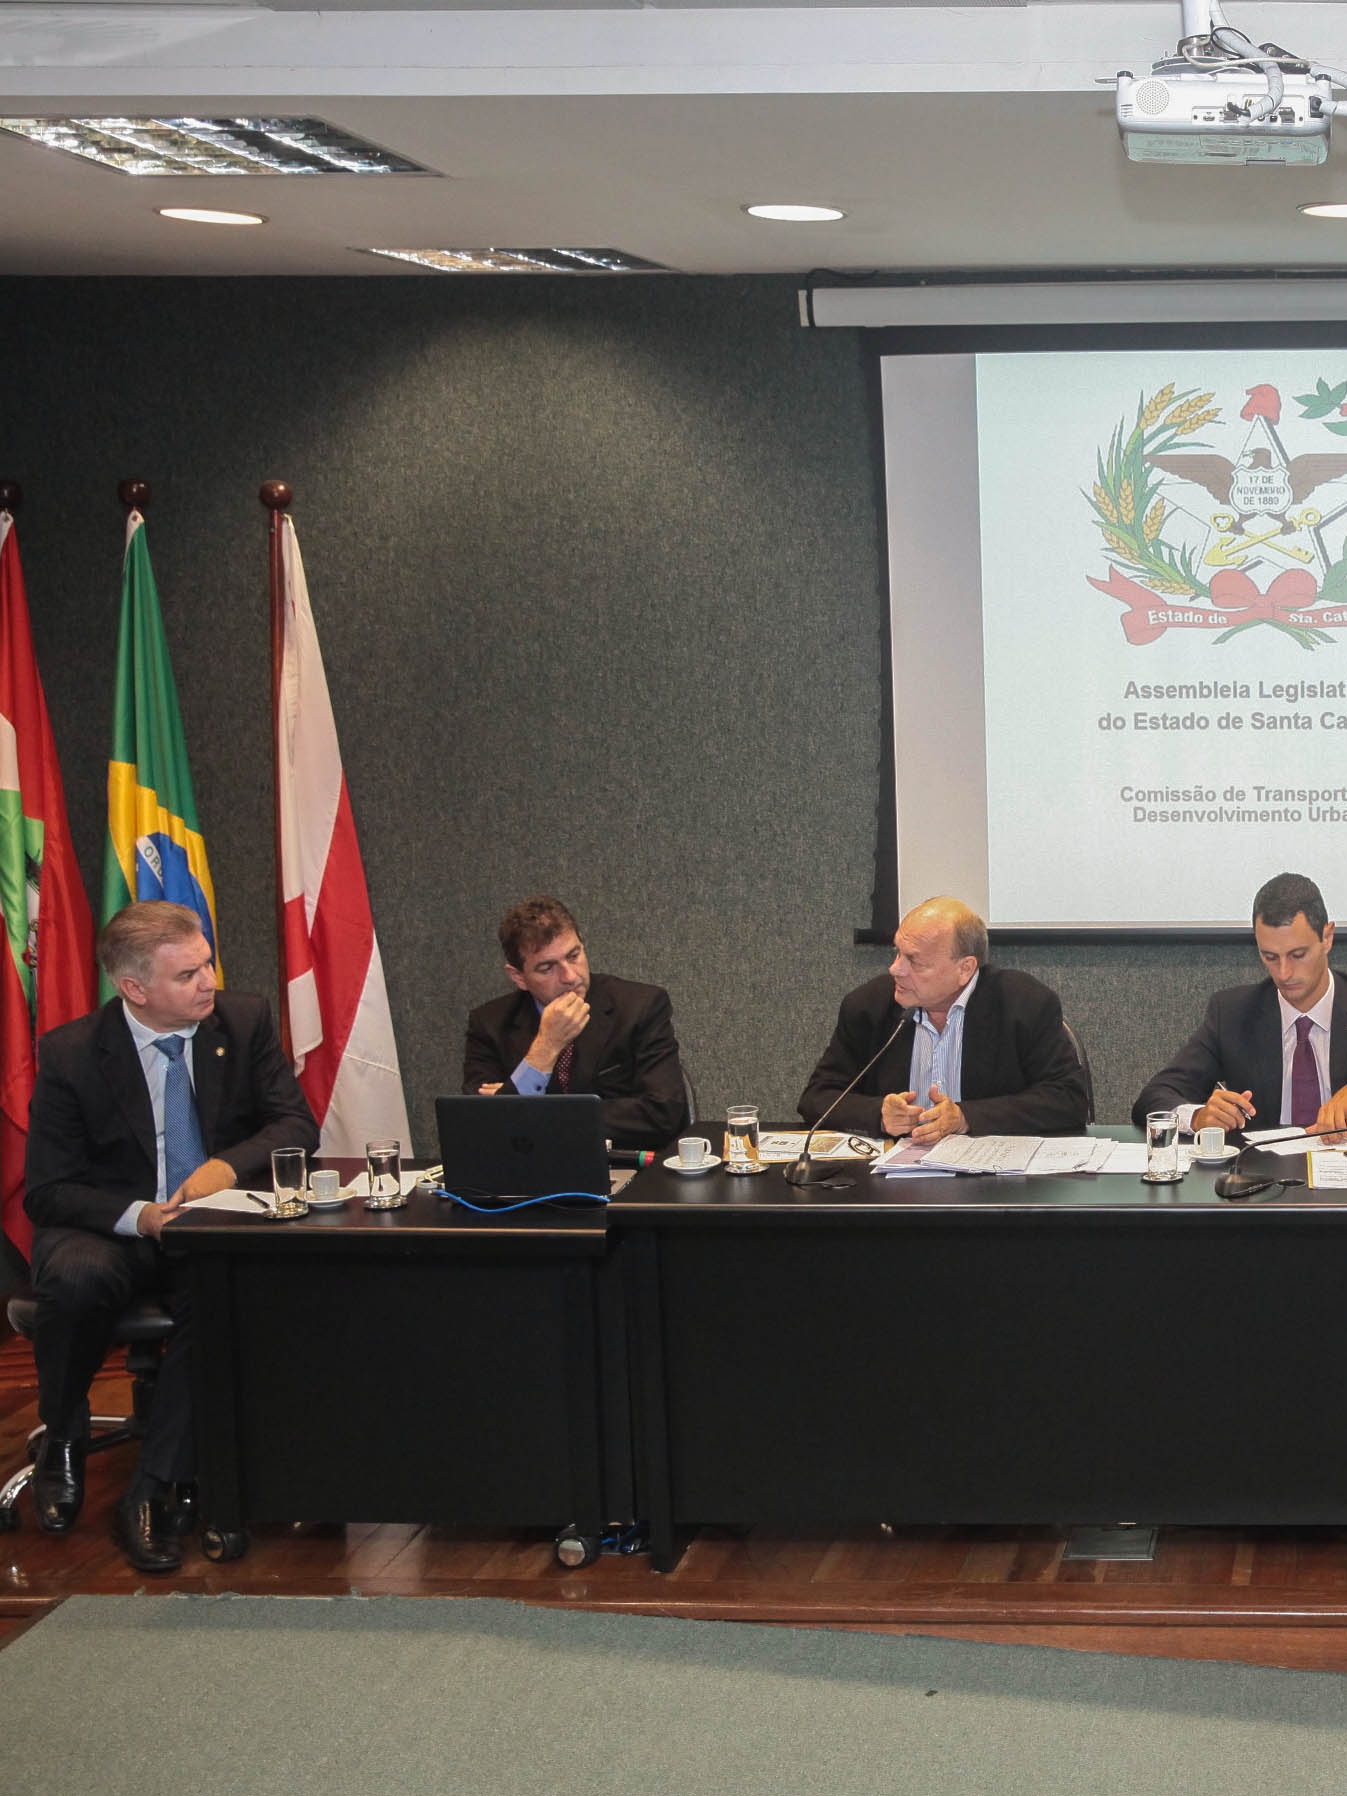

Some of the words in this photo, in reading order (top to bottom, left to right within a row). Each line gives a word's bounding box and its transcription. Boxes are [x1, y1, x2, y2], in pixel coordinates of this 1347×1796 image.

[1262, 475, 1274, 484] DE
[1243, 496, 1255, 505] DE
[1147, 609, 1204, 625] Estado
[1288, 613, 1318, 624] Sta.
[1123, 680, 1251, 699] Assembleia
[1097, 712, 1126, 730] do
[1133, 712, 1211, 730] Estado
[1216, 712, 1244, 730] de
[1250, 712, 1313, 730] Santa
[1120, 785, 1217, 802] Comissão
[1222, 785, 1247, 802] de
[1133, 806, 1302, 823] Desenvolvimento
